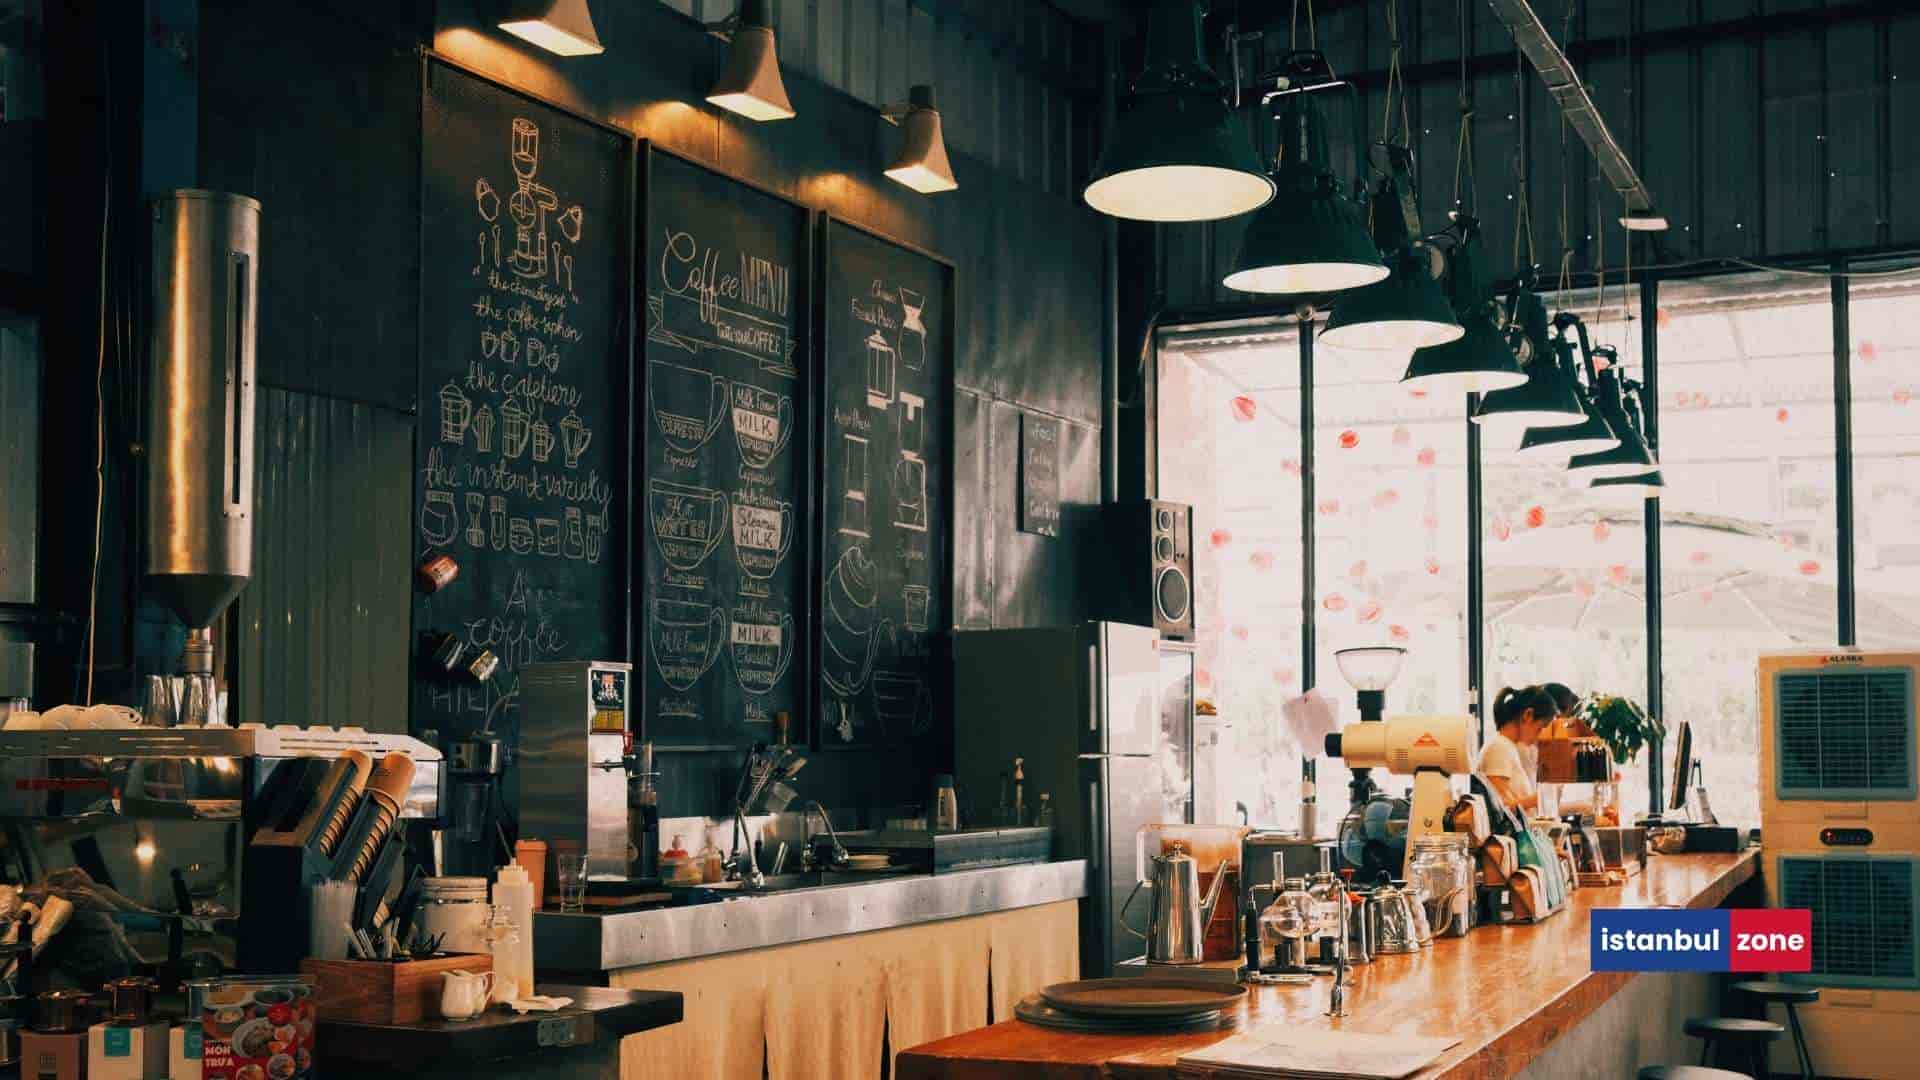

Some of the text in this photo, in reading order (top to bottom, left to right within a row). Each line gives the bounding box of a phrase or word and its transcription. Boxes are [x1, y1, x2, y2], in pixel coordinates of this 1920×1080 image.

[661, 226, 739, 324] Coffee
[472, 295, 504, 321] the
[463, 360, 499, 393] the
[738, 414, 772, 438] MILK
[421, 446, 462, 489] the
[463, 457, 543, 502] instant
[739, 526, 774, 549] MILK
[737, 626, 775, 643] MILK
